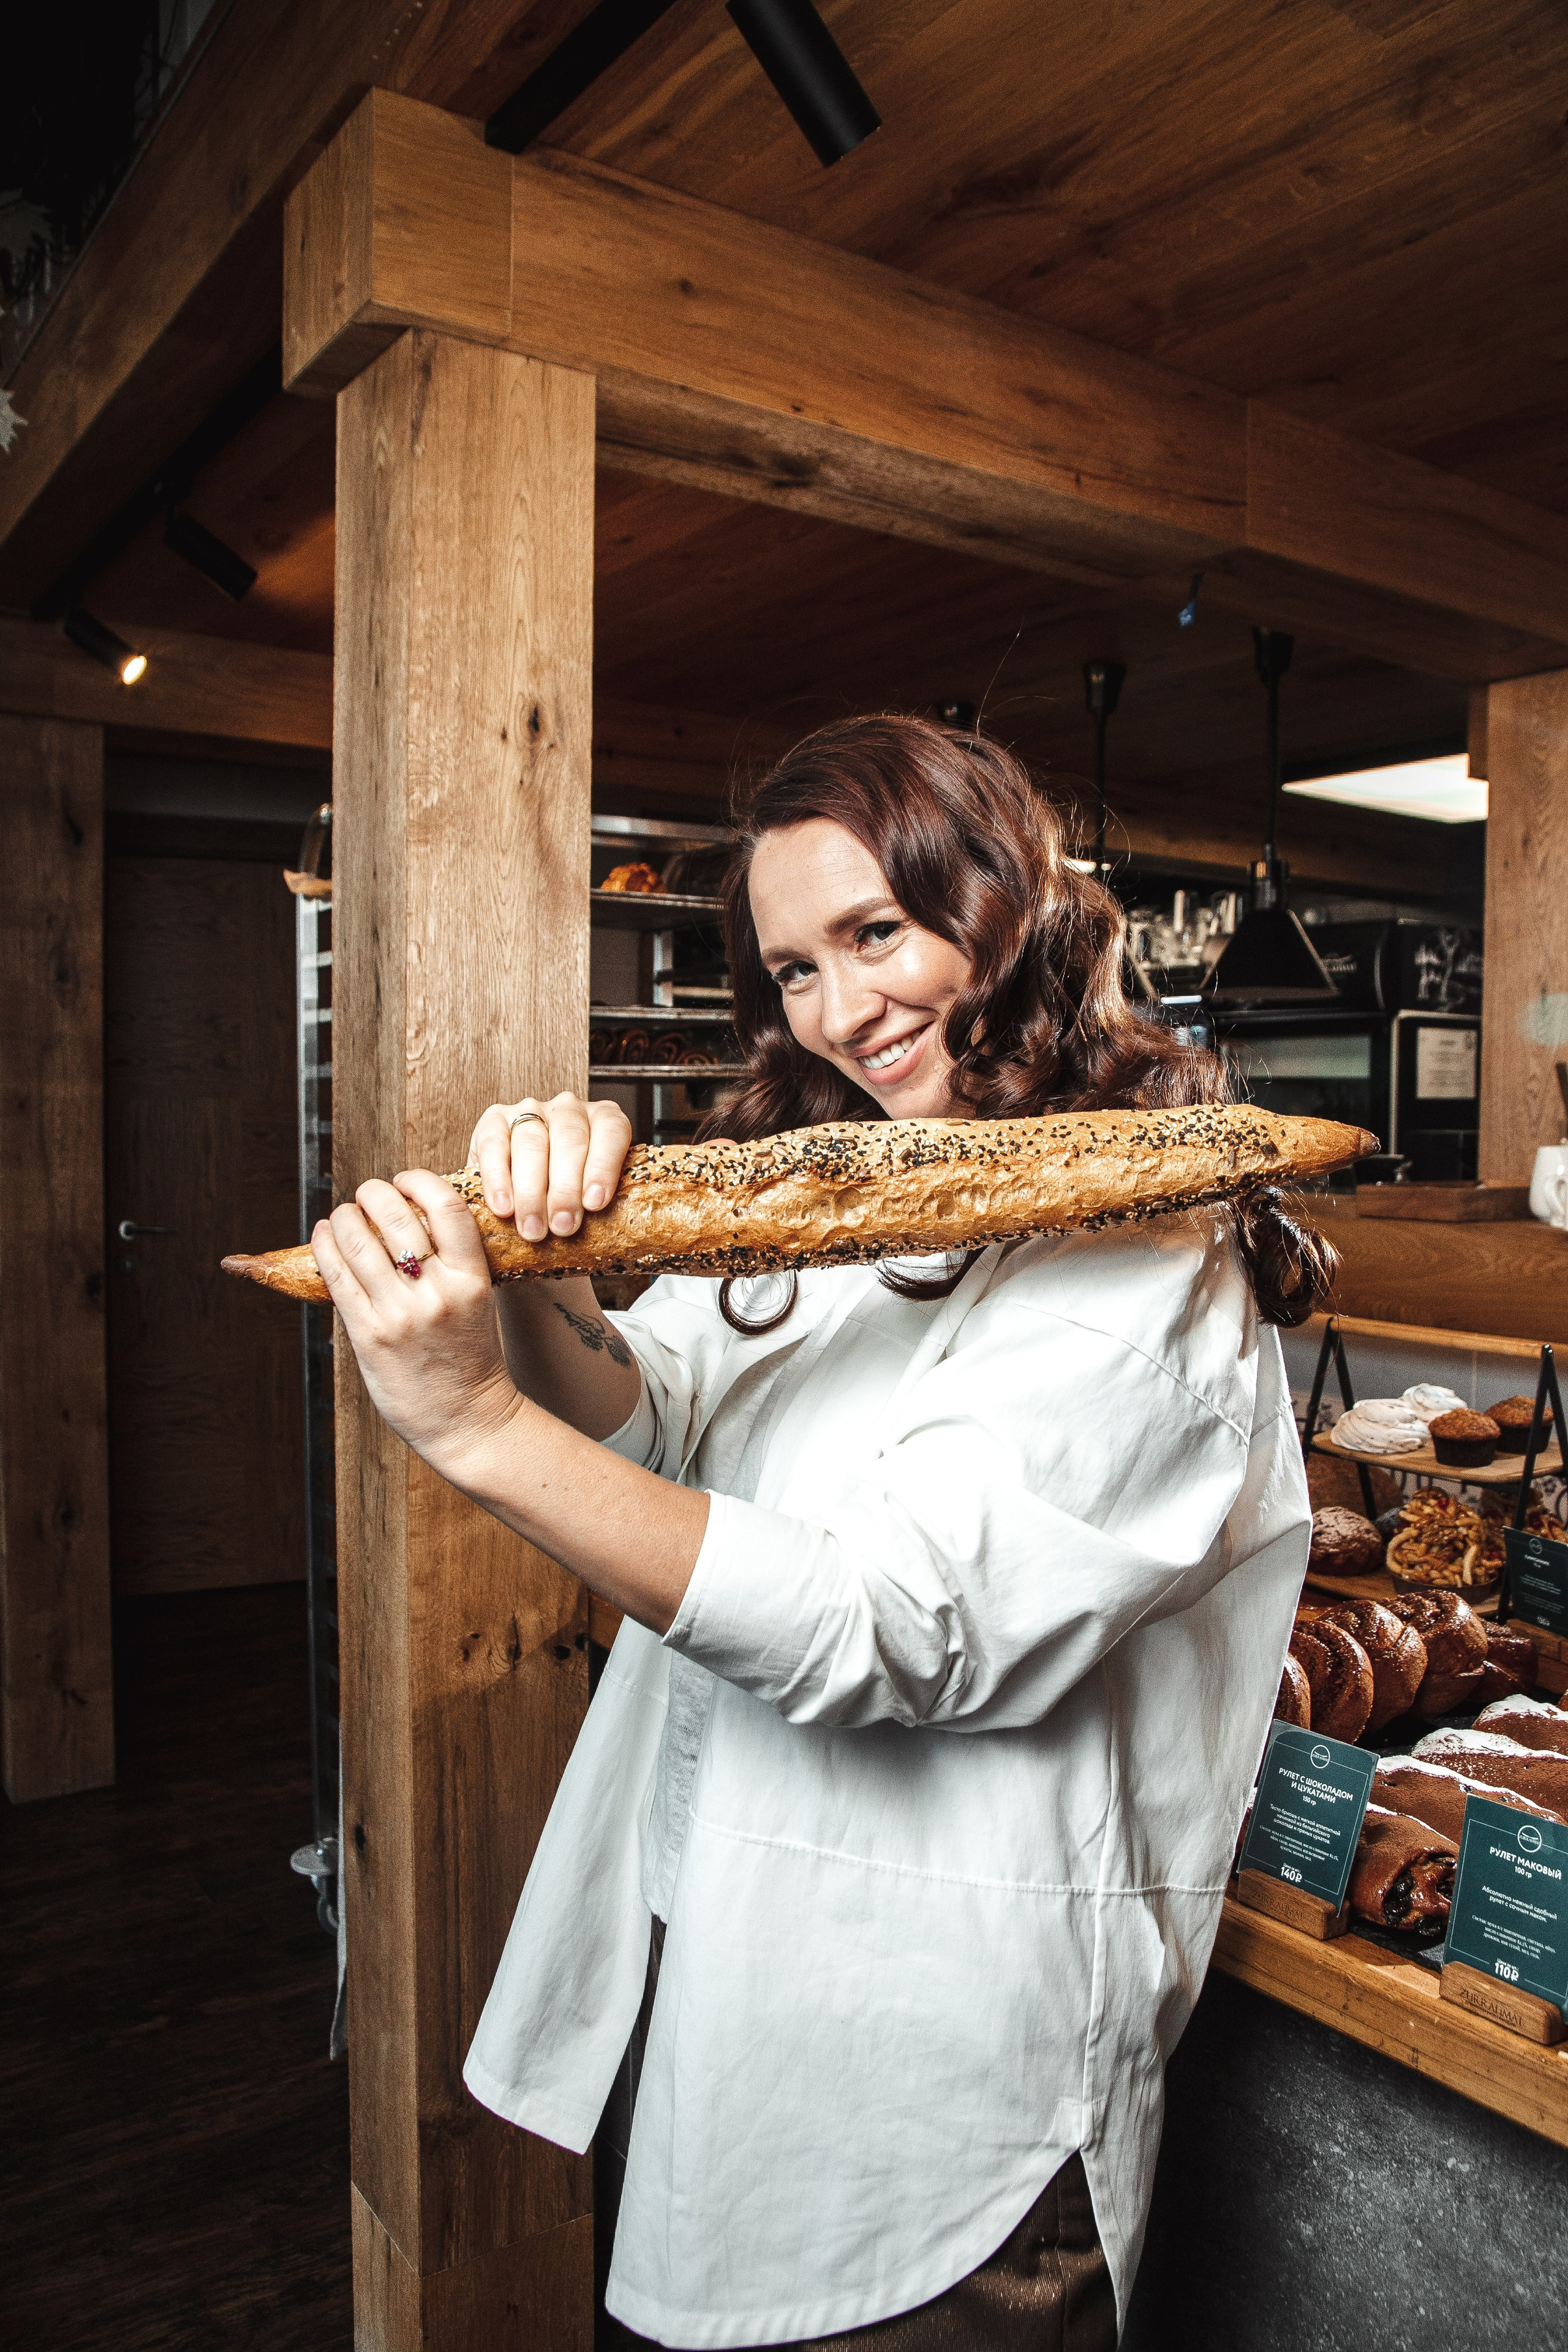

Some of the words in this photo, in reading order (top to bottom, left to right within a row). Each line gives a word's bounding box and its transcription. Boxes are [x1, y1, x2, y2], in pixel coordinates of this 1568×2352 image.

[1279, 1768, 1300, 1780] РУЛЕТ
[1305, 1777, 1353, 1801] ШОКОЛАДОМ
[1297, 1784, 1336, 1803] ЦУКАТАМИ
[1274, 1819, 1293, 1829] шоколада
[1297, 1828, 1313, 1837] пряных
[1313, 1834, 1330, 1844] цукатов.
[1277, 1814, 1296, 1824] начинкой
[1302, 1823, 1330, 1838] бельгийского
[1281, 1809, 1297, 1819] бриошь
[1301, 1817, 1315, 1826] мягкой
[1316, 1823, 1340, 1836] аппетитной
[1490, 1847, 1517, 1862] РУЛЕТ
[1517, 1856, 1561, 1880] МАКОВЫЙ
[1515, 1866, 1525, 1875] 100
[1482, 1886, 1512, 1901] Абсолютно
[1512, 1898, 1533, 1910] нежный
[1534, 1907, 1557, 1920] сдобный
[1490, 1896, 1504, 1904] рулет
[1509, 1904, 1528, 1915] сочным
[1529, 1912, 1547, 1922] маком.
